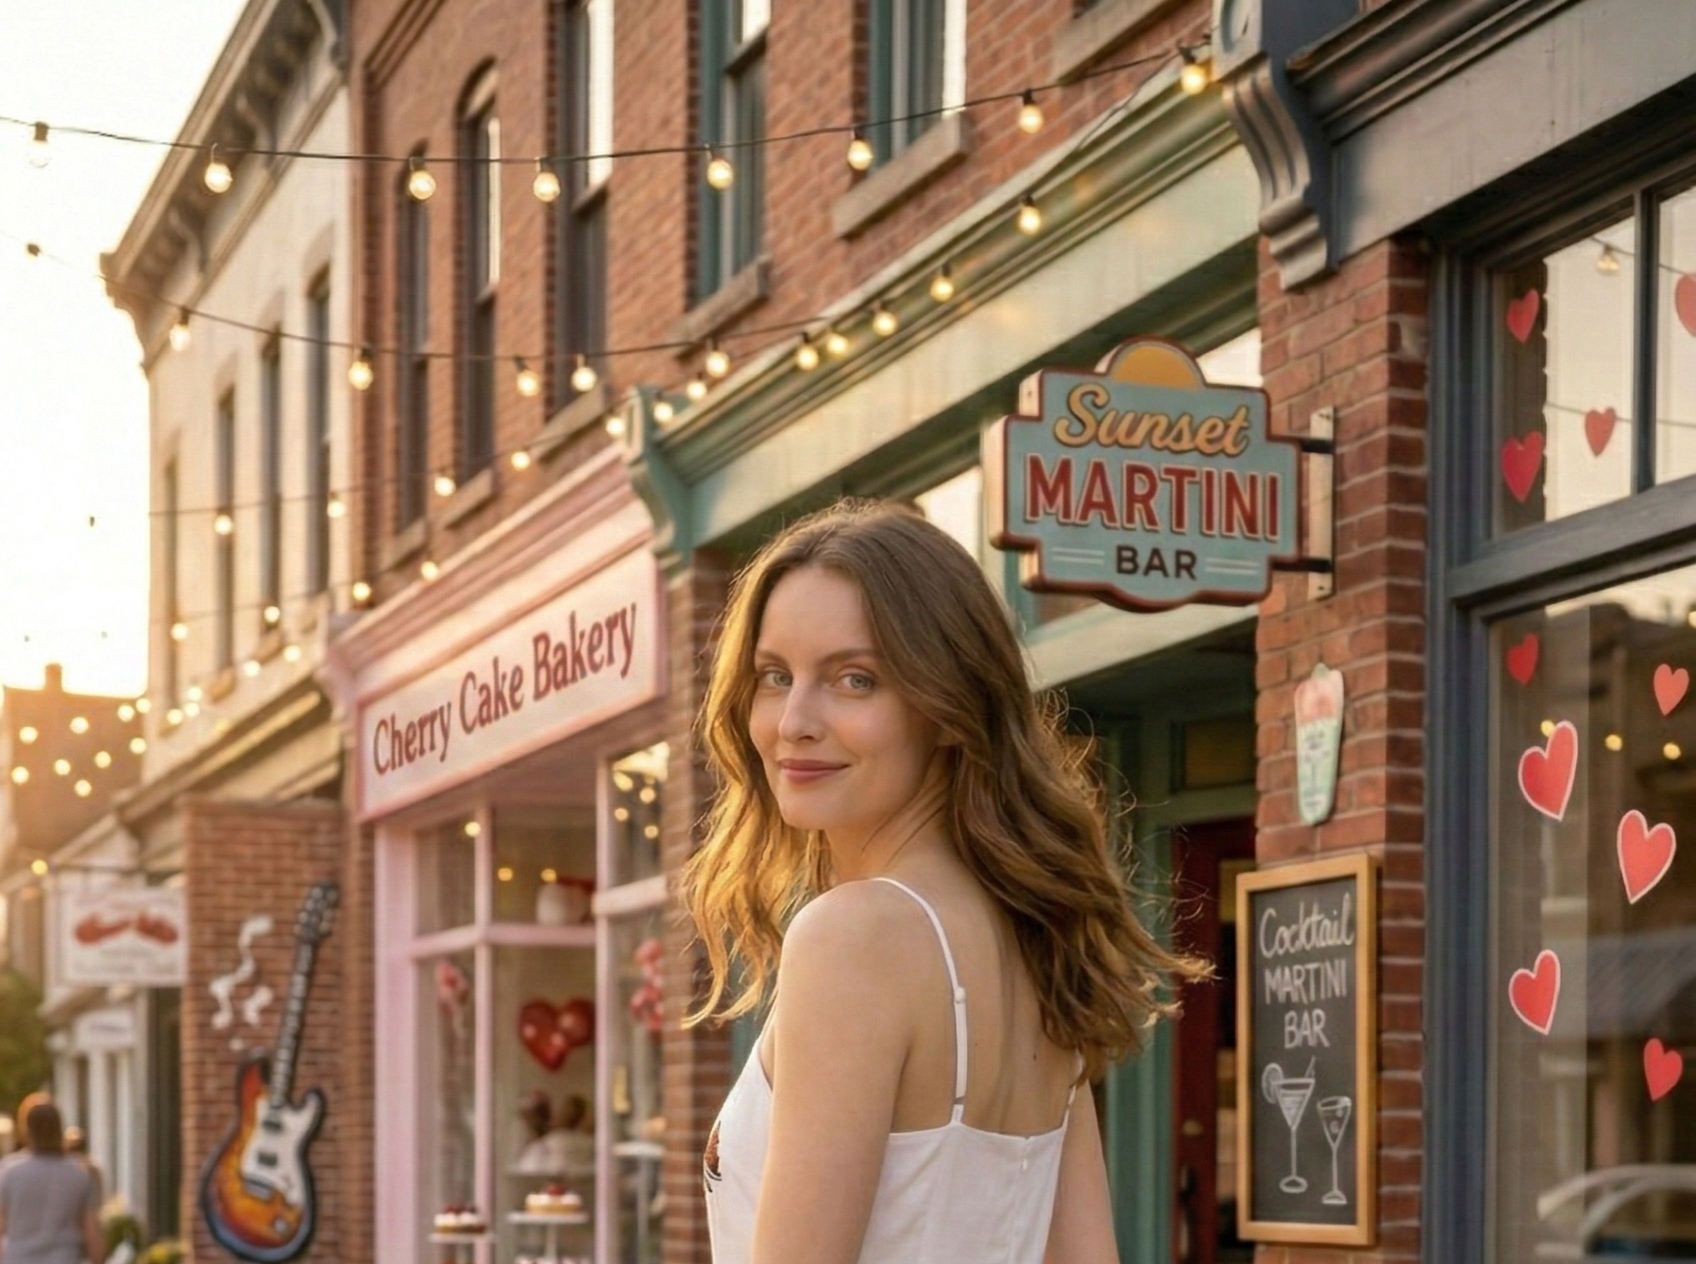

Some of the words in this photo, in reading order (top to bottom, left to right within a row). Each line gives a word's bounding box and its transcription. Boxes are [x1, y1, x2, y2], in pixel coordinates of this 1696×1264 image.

[1054, 383, 1250, 457] Sunset
[1025, 453, 1281, 541] MARTINI
[1115, 545, 1198, 580] BAR
[373, 701, 452, 775] Cherry
[459, 656, 524, 735] Cake
[532, 602, 637, 702] Bakery
[1259, 893, 1354, 958] Cocktail
[1264, 959, 1348, 1005] MARTINI
[1284, 1008, 1331, 1049] BAR
